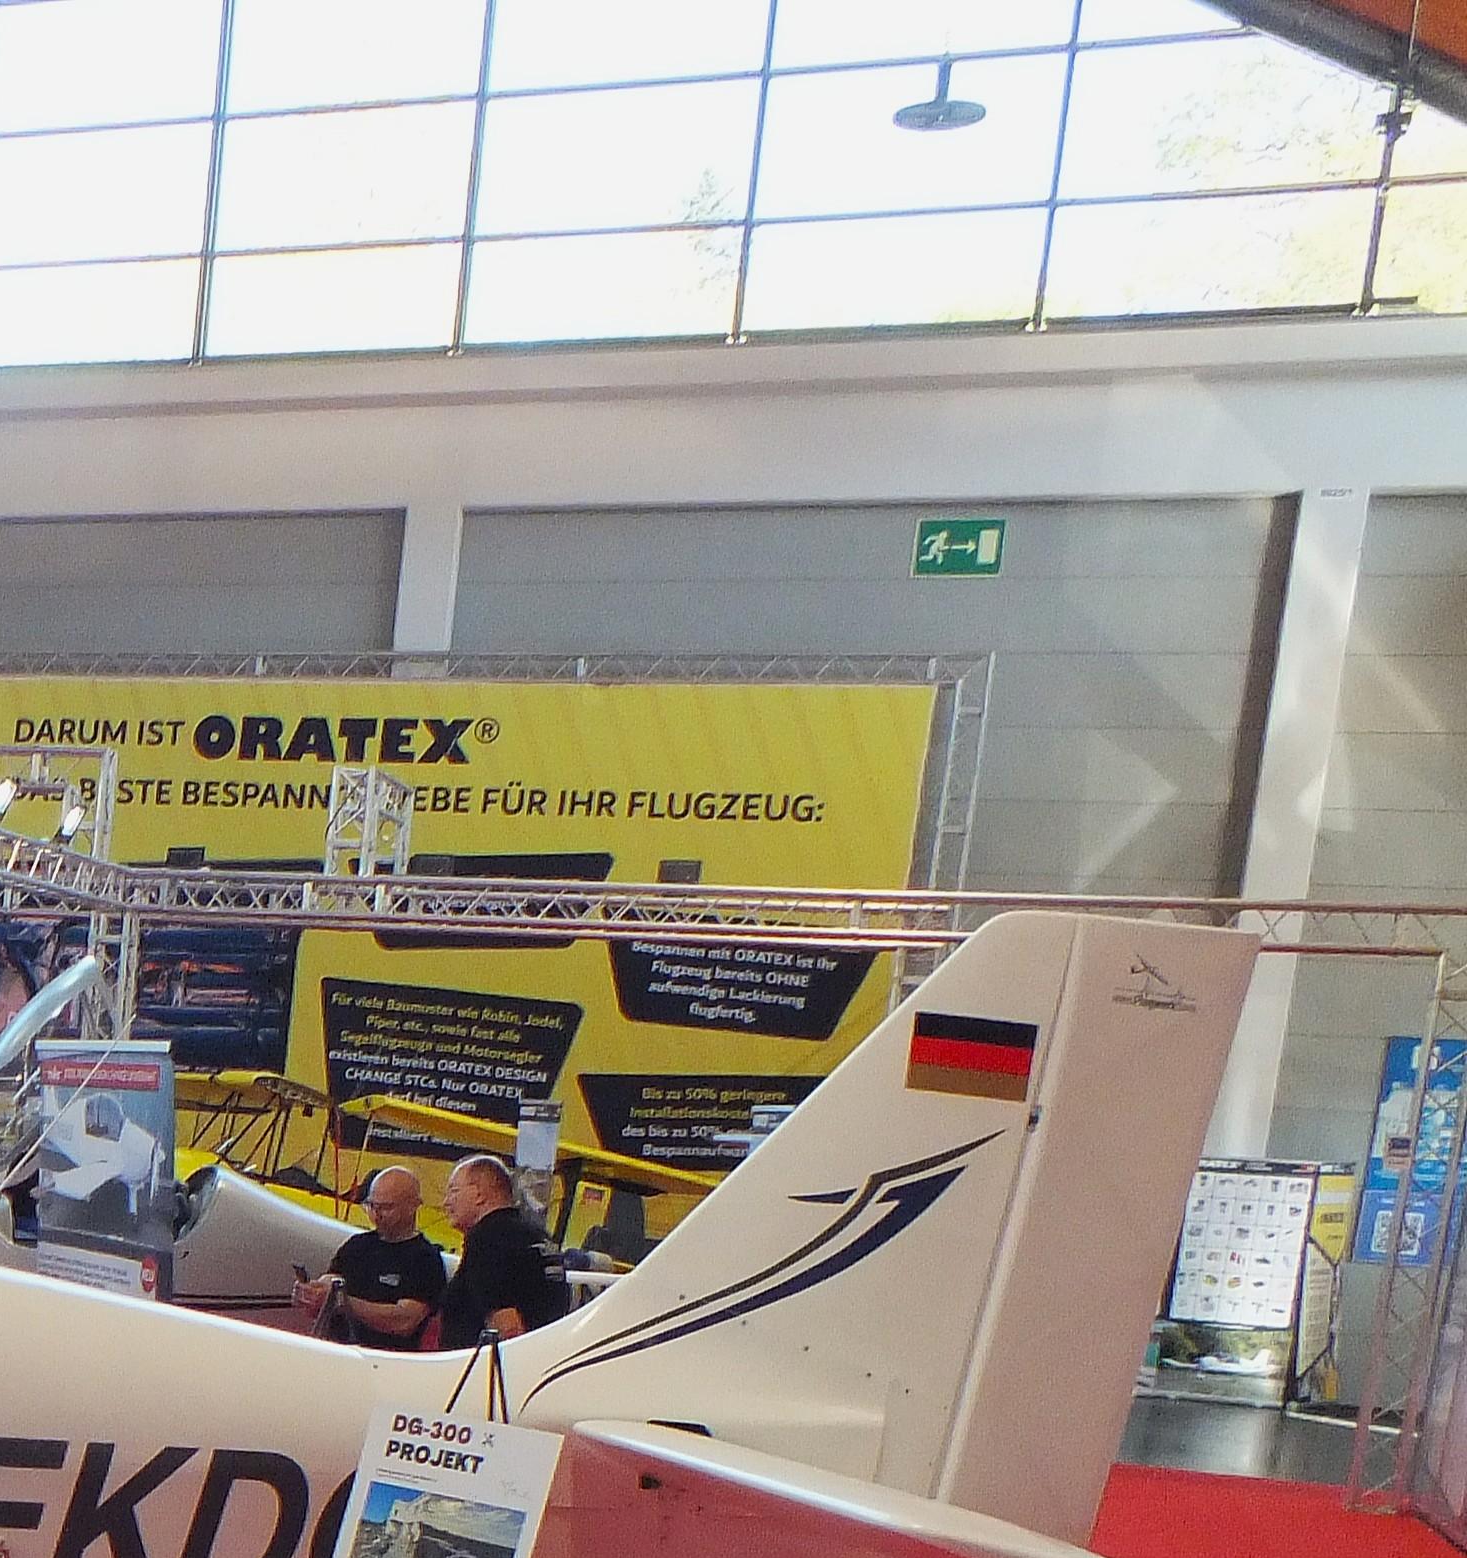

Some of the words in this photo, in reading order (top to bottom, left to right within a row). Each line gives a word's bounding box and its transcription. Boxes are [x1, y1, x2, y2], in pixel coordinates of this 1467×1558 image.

[14, 718, 127, 745] DARUM
[137, 720, 185, 746] IST
[79, 777, 173, 806] BSTE
[480, 781, 546, 816] FÜR
[557, 789, 616, 817] IHR
[626, 791, 825, 822] FLUGZEUG:
[734, 949, 794, 967] ORATEX
[651, 960, 712, 980] Flugzeug
[765, 971, 810, 988] OHNE
[331, 991, 353, 1006] Für
[355, 996, 384, 1010] viele
[386, 998, 454, 1017] Baumuster
[435, 1040, 460, 1055] und
[391, 1053, 435, 1070] bereits
[437, 1058, 493, 1078] ORATEX
[494, 1065, 548, 1084] DESIGN
[344, 1067, 402, 1085] CHANGE
[441, 1078, 467, 1093] Nur
[468, 1080, 523, 1100] ORATEX
[621, 1125, 646, 1138] des
[648, 1124, 668, 1138] bis
[391, 1413, 472, 1446] DG-300
[384, 1439, 485, 1475] PROJEKT
